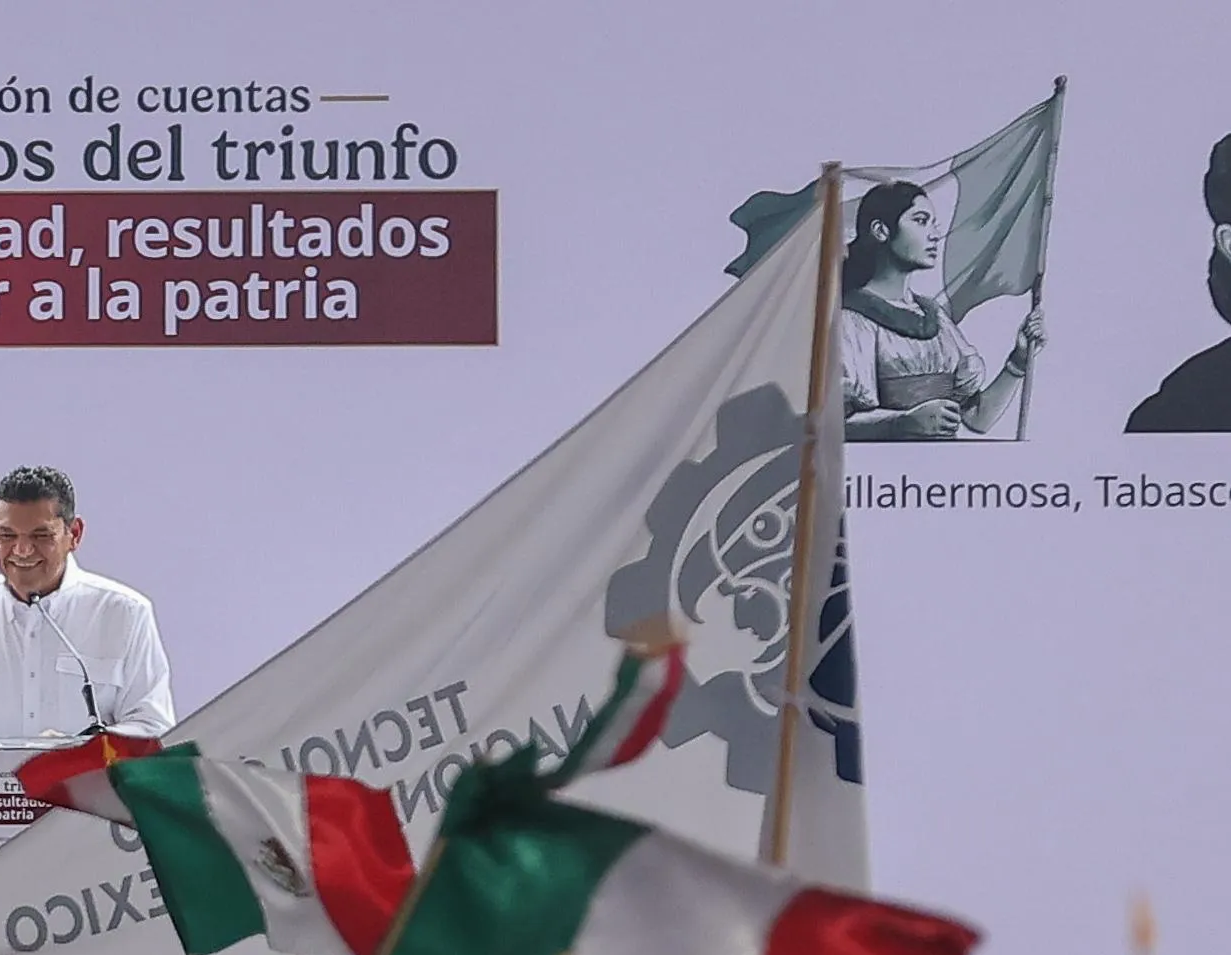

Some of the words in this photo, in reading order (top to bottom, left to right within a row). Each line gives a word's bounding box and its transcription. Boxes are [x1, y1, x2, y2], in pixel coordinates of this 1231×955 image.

[68, 75, 120, 114] de
[137, 81, 311, 114] cuentas
[83, 122, 186, 183] del
[211, 122, 459, 183] triunfo
[106, 203, 451, 259] resultados
[29, 280, 64, 321] a
[88, 266, 140, 321] la
[164, 266, 360, 336] patria
[844, 474, 1084, 514] illahermosa,
[1094, 473, 1231, 508] Tabasc
